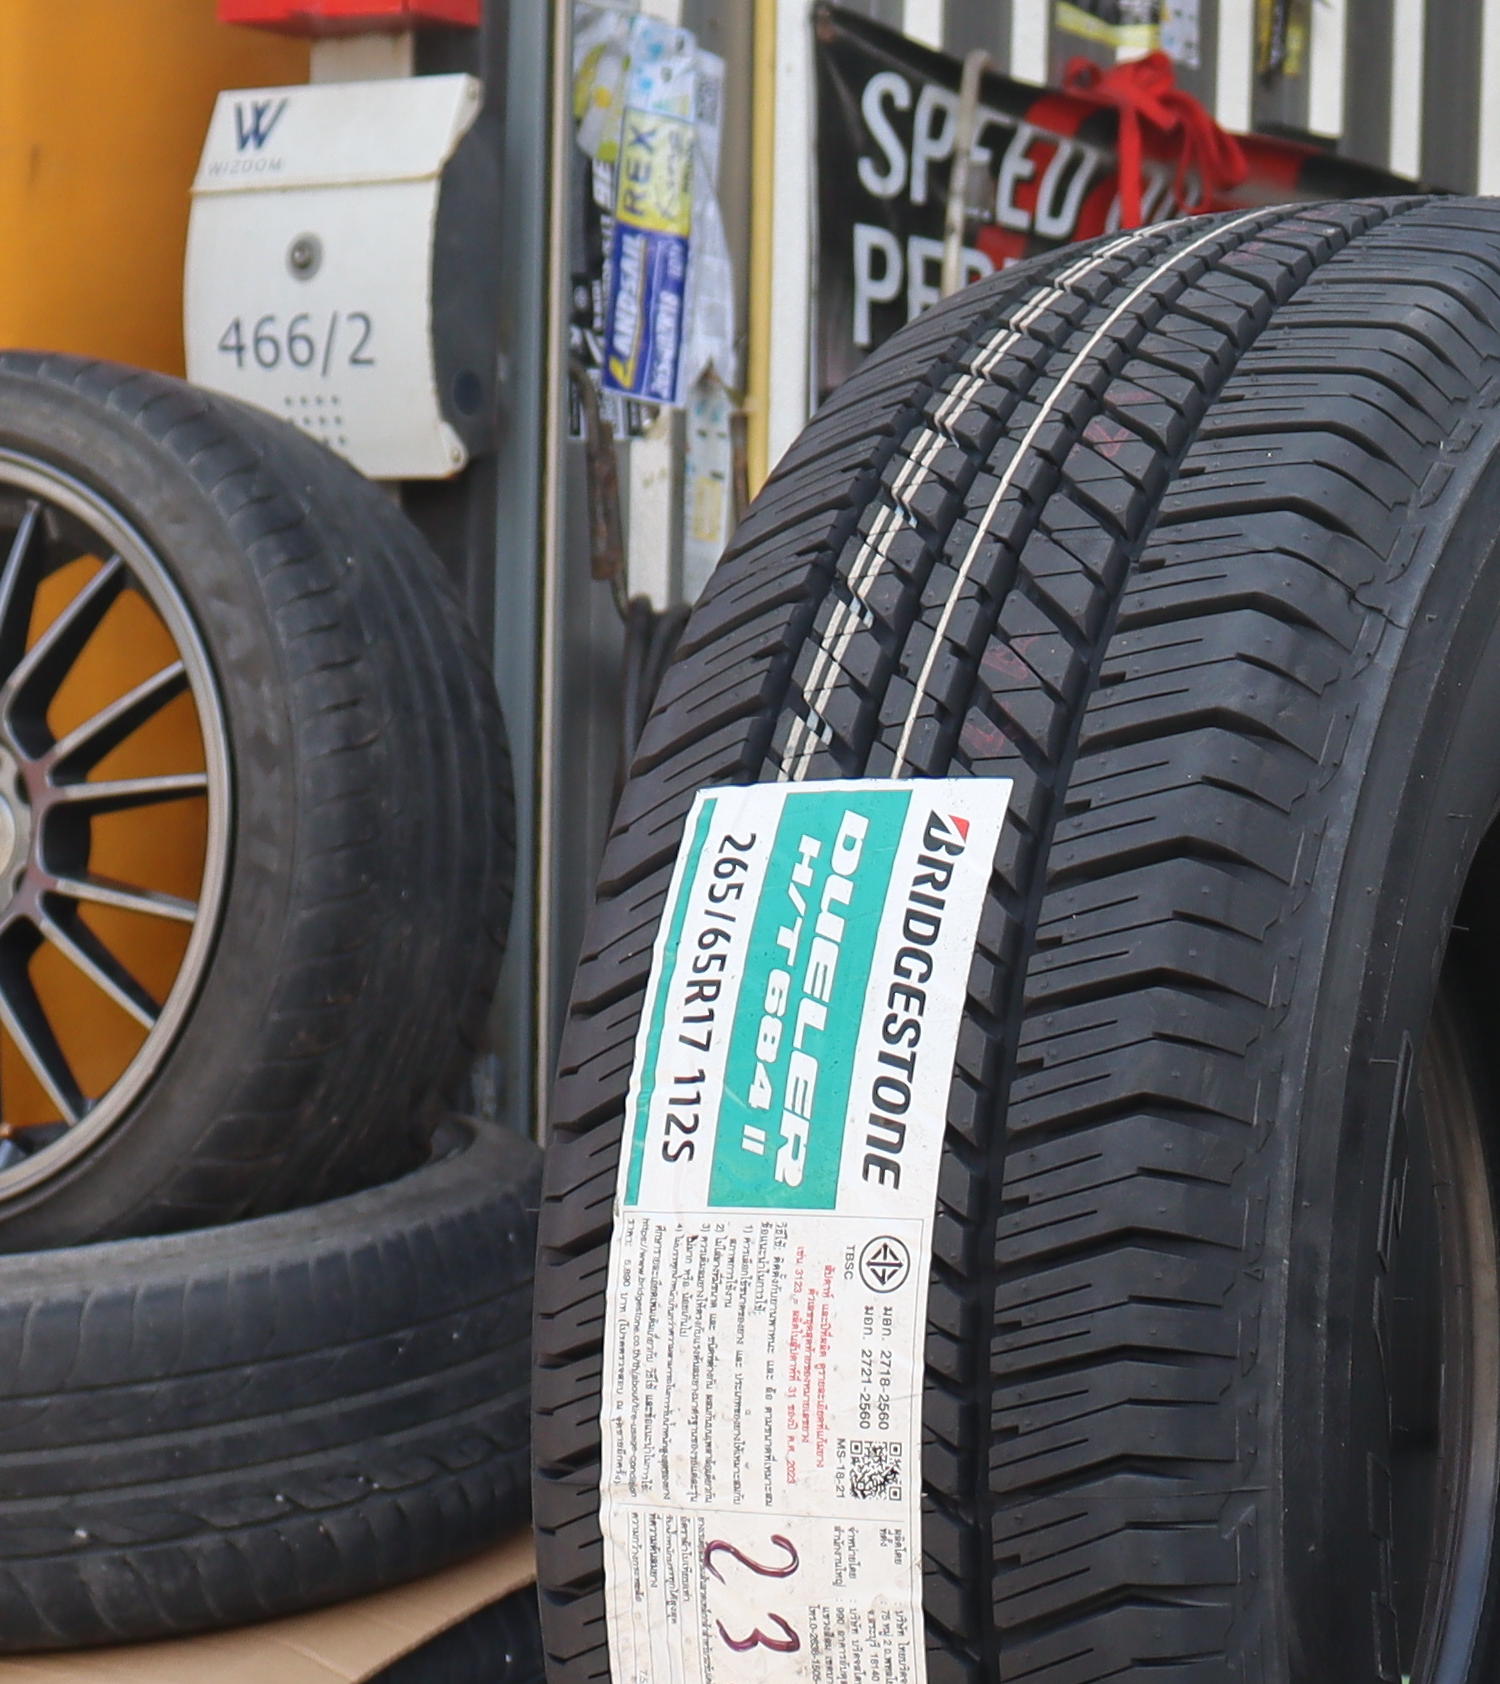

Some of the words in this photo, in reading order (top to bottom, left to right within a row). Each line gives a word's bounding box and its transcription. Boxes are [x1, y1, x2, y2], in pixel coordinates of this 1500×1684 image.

[234, 97, 289, 152] W
[857, 71, 1100, 239] SPEED
[208, 157, 283, 177] WIZDOM
[624, 123, 656, 218] REX
[217, 311, 376, 377] 466/2
[608, 233, 644, 389] LANDSAIL
[776, 833, 822, 967] H/T
[677, 832, 758, 1053] 265/65R17
[774, 809, 871, 1188] DUELER
[861, 809, 971, 1191] BRIDGESTONE
[748, 967, 792, 1111] 684
[661, 1069, 707, 1164] 112S
[793, 1269, 803, 1292] 3123
[843, 1244, 855, 1280] TBSC
[862, 1305, 874, 1339] มอก.
[880, 1305, 892, 1340] มอก.
[787, 1386, 796, 1397] 31
[858, 1349, 872, 1429] 2721-2560
[877, 1349, 891, 1430] 2718-2560
[785, 1459, 796, 1484] 2023
[835, 1438, 846, 1498] MS-18-21
